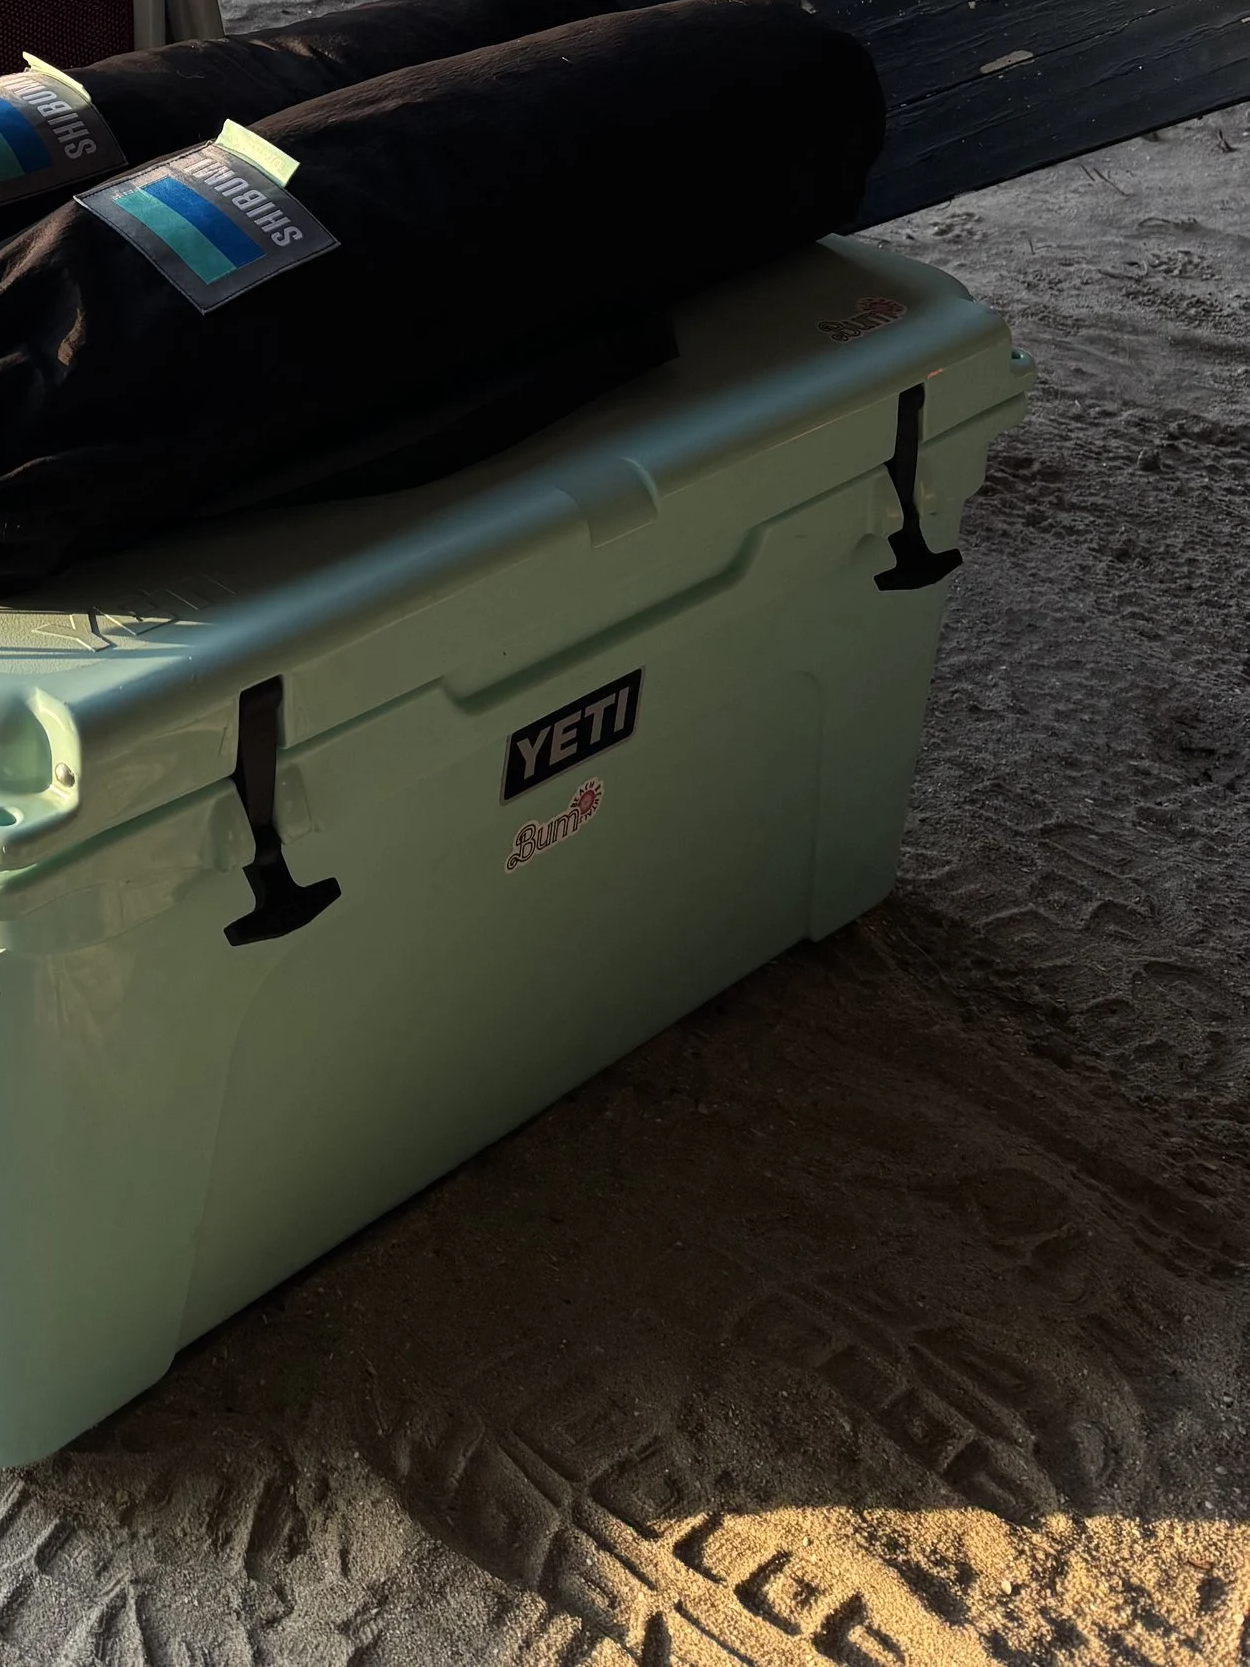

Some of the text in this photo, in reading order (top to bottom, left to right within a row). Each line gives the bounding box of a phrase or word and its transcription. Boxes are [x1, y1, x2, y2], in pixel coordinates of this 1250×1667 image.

[183, 158, 303, 247] SHIBUMI
[517, 686, 630, 780] YETI
[507, 808, 579, 870] Bum
